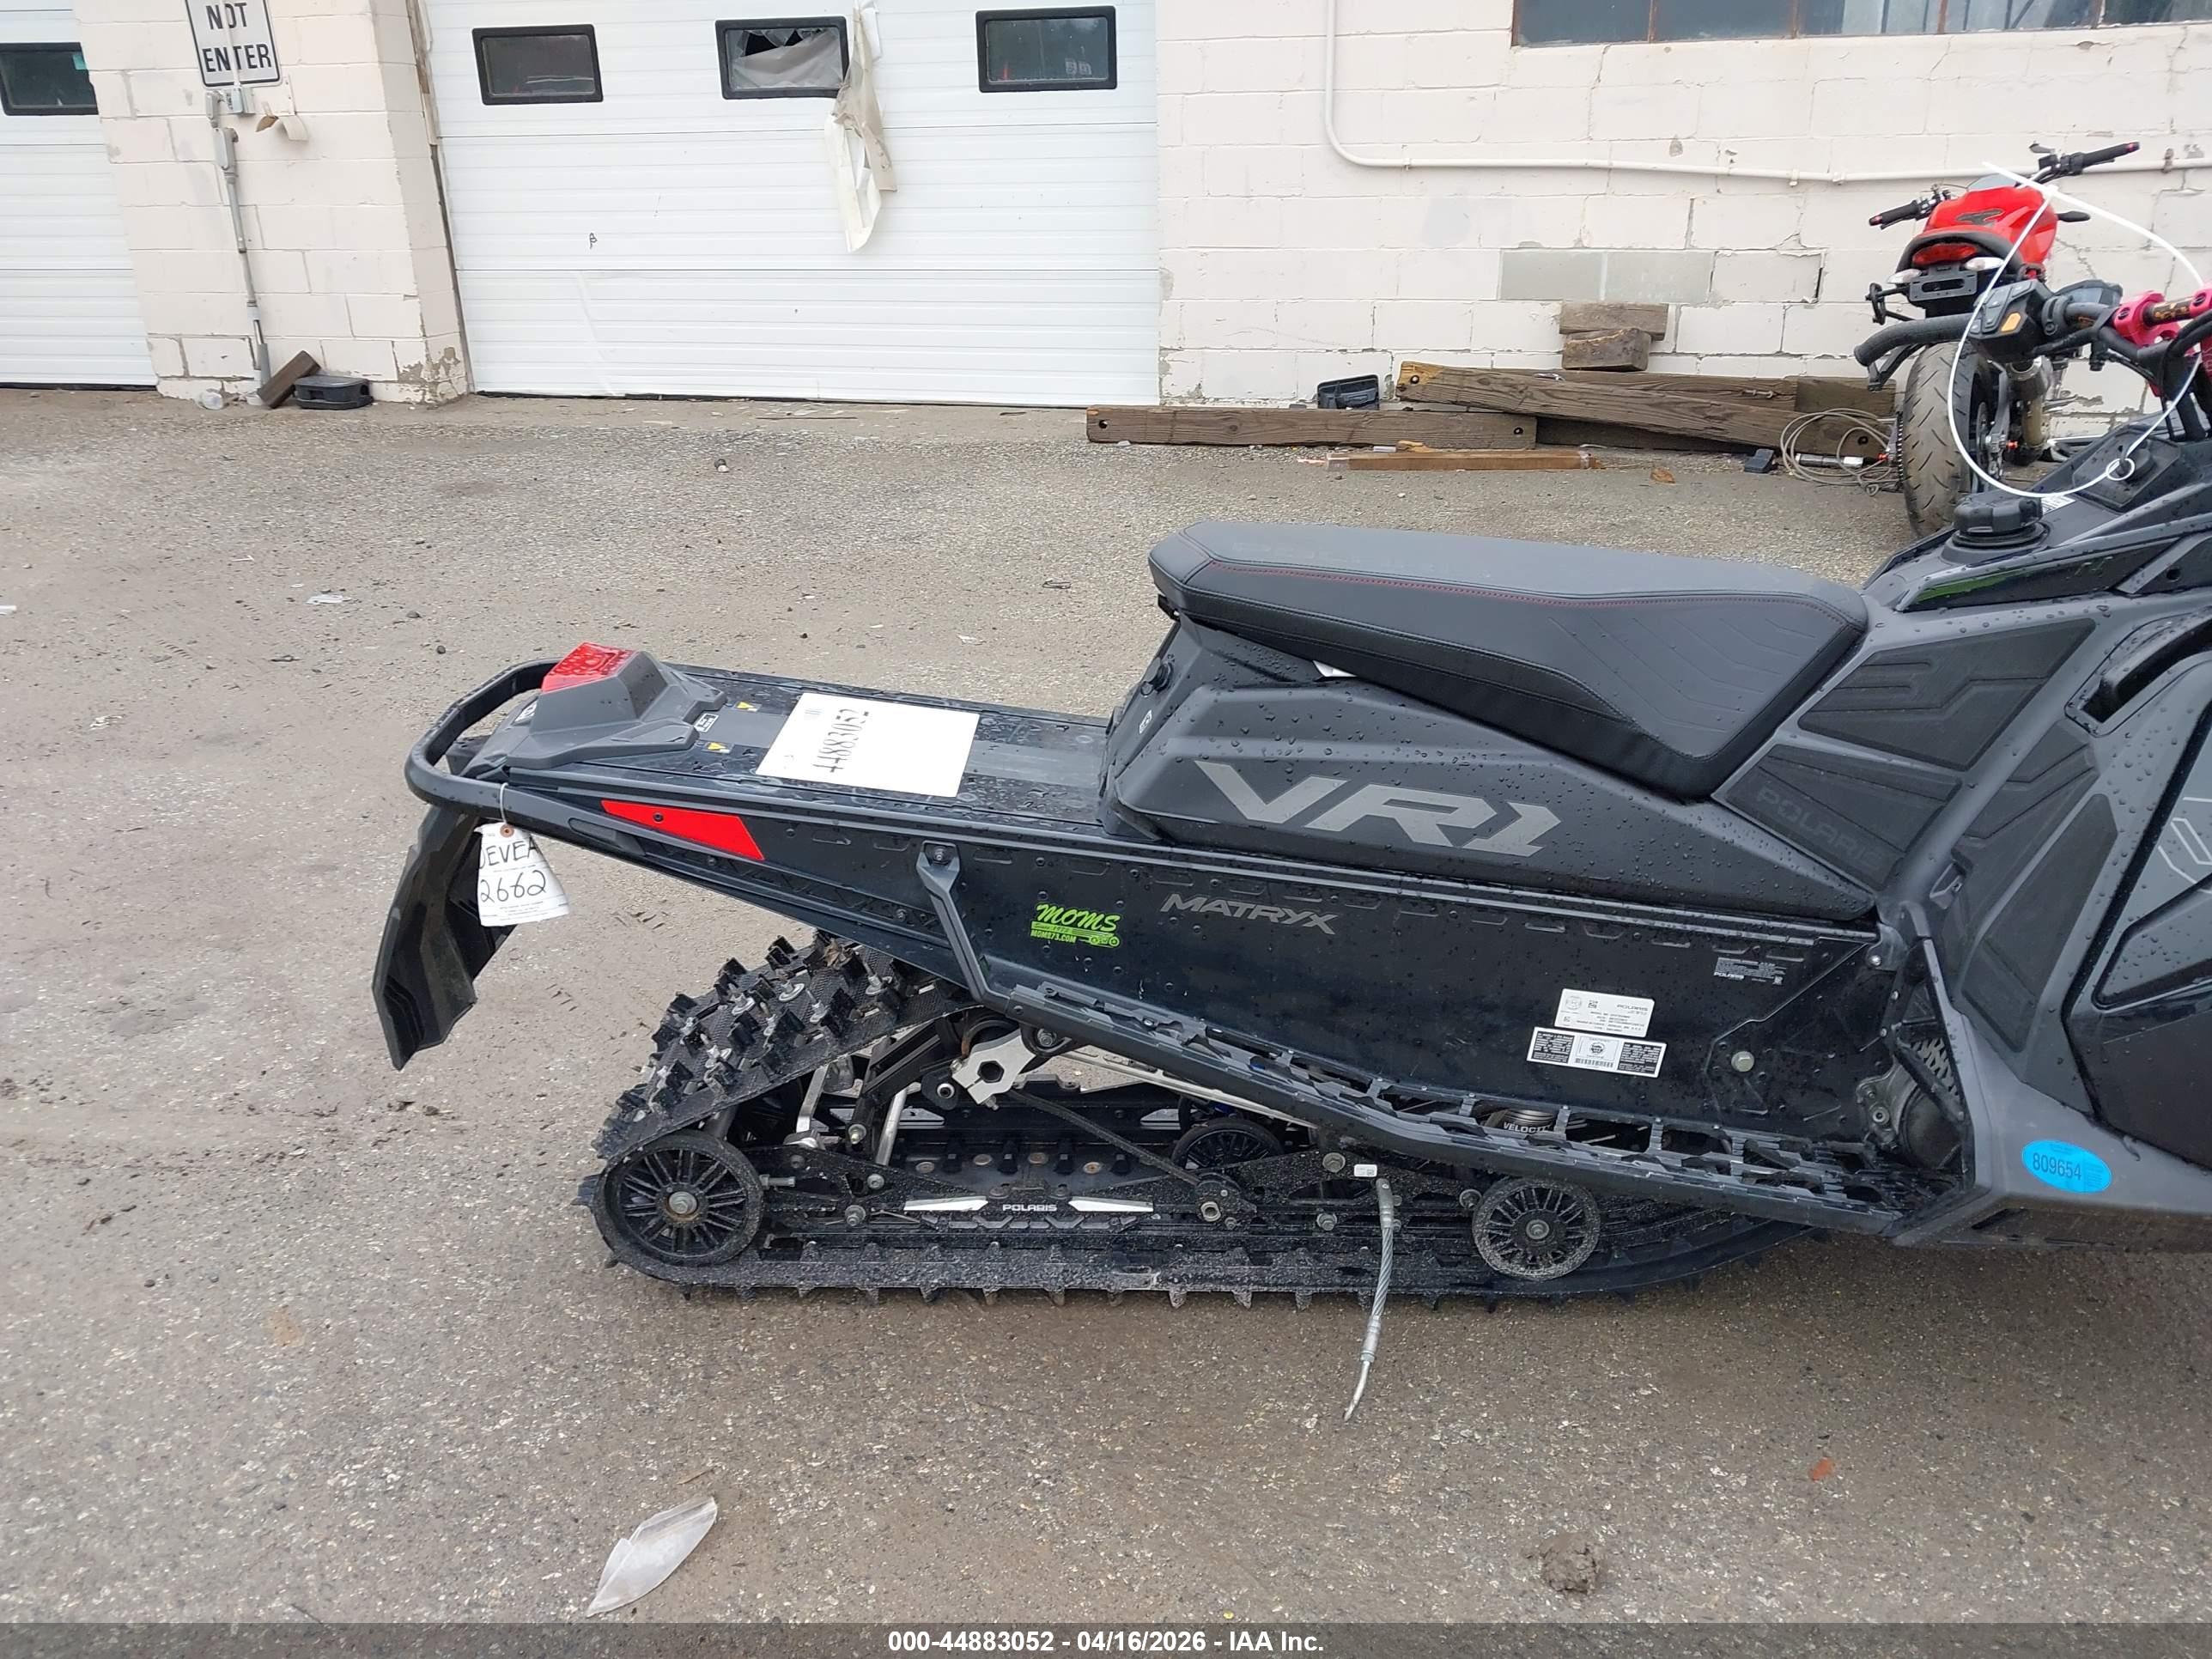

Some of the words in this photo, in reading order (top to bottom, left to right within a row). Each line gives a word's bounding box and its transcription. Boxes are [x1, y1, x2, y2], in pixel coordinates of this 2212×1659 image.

[206, 3, 247, 30] NOT
[202, 44, 272, 72] ENTER
[812, 708, 871, 773] 44883052
[1194, 760, 1562, 857] VR1
[480, 869, 547, 903] 2662
[1159, 893, 1340, 935] MATRYX
[2033, 1152, 2082, 1181] 809654
